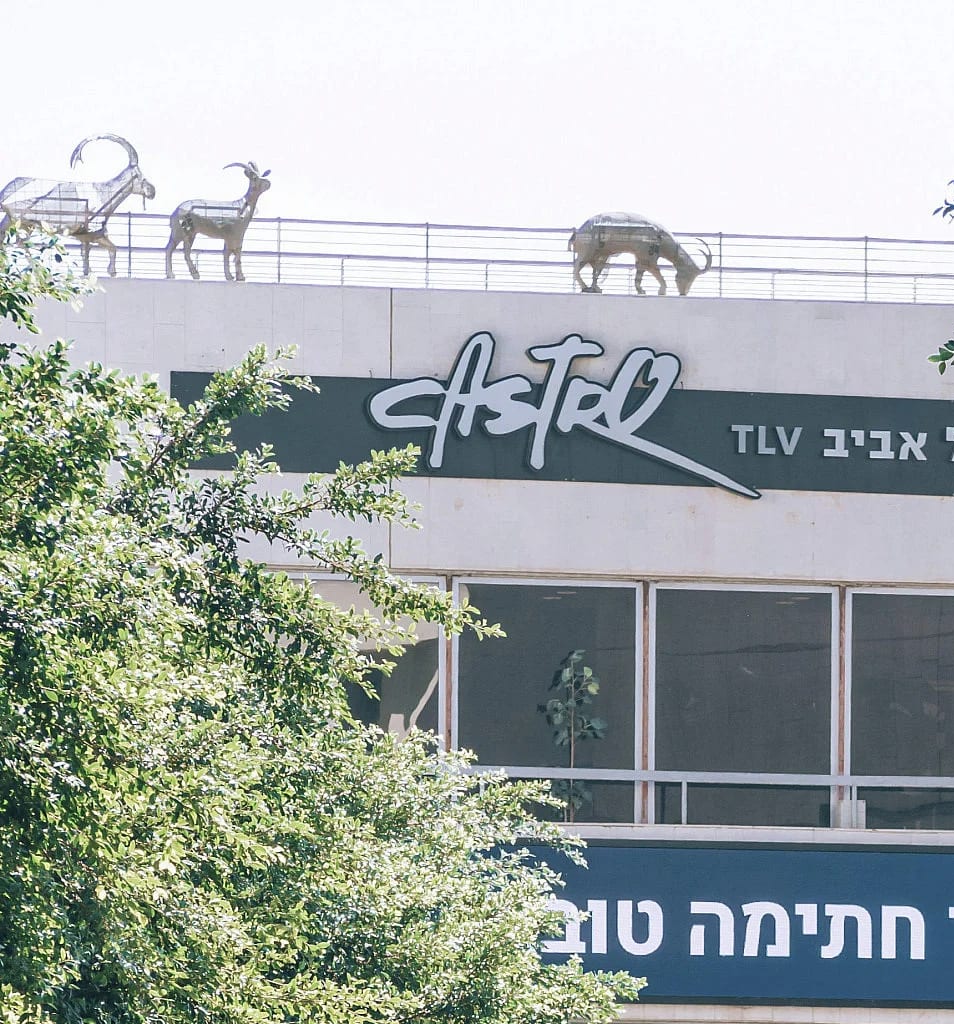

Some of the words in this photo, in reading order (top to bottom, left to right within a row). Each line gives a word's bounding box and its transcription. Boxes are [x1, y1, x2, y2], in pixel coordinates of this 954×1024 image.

[731, 424, 802, 455] TLV
[823, 428, 928, 461] אביב
[689, 900, 926, 960] חתימה
